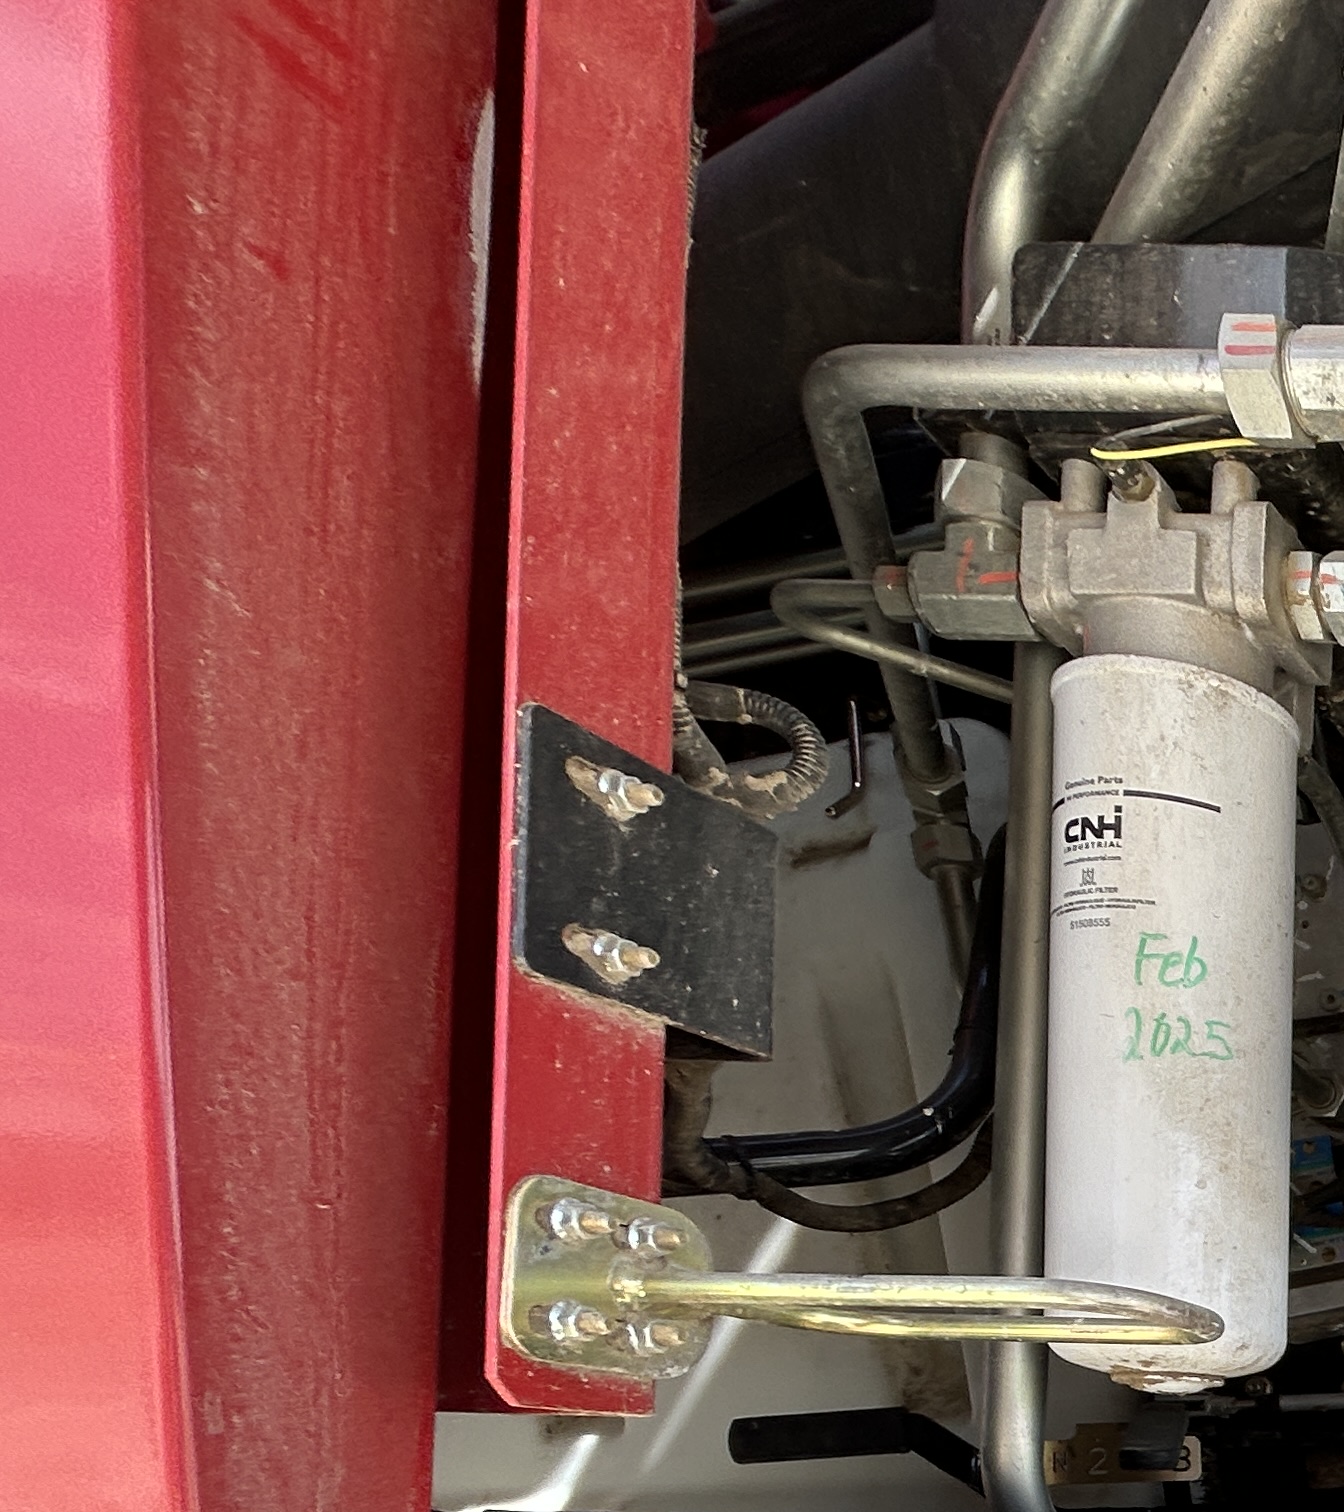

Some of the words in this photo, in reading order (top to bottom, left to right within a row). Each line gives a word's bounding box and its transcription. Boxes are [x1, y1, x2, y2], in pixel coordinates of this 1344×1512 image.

[1098, 775, 1124, 785] Parts
[1134, 931, 1208, 989] Feb
[1122, 1006, 1235, 1063] 2025
[1087, 1447, 1108, 1475] 2
